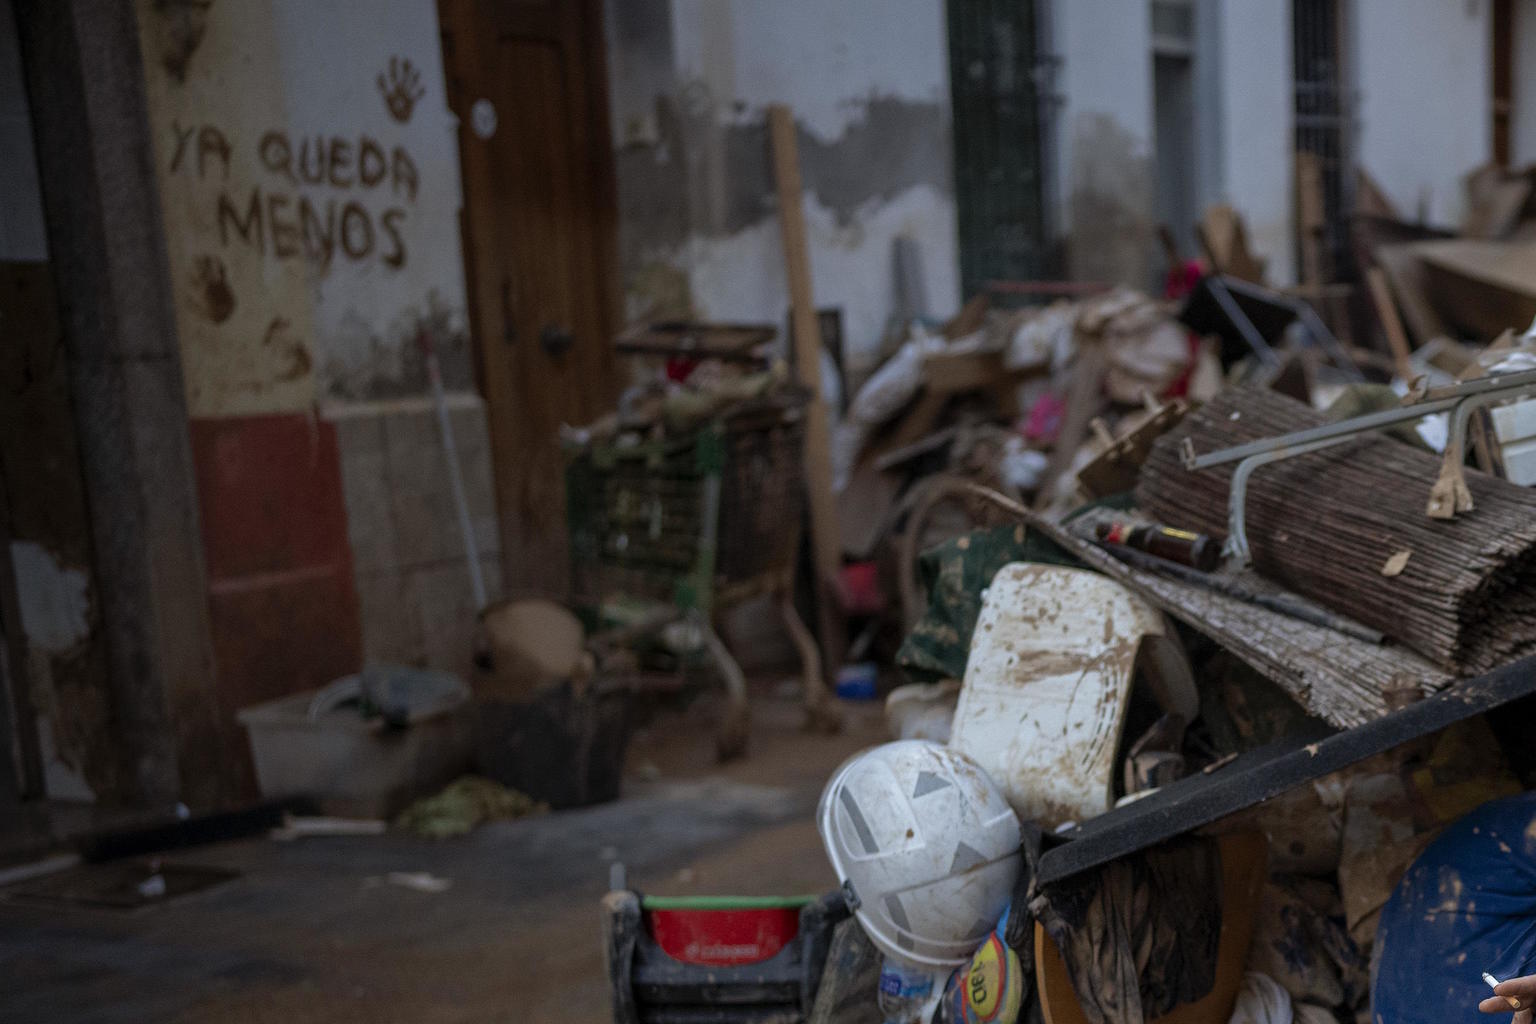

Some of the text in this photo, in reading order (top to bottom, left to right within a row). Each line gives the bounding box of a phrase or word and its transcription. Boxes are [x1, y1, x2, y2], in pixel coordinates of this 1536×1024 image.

[169, 119, 420, 202] YA QUEDA
[217, 188, 408, 270] MENOS
